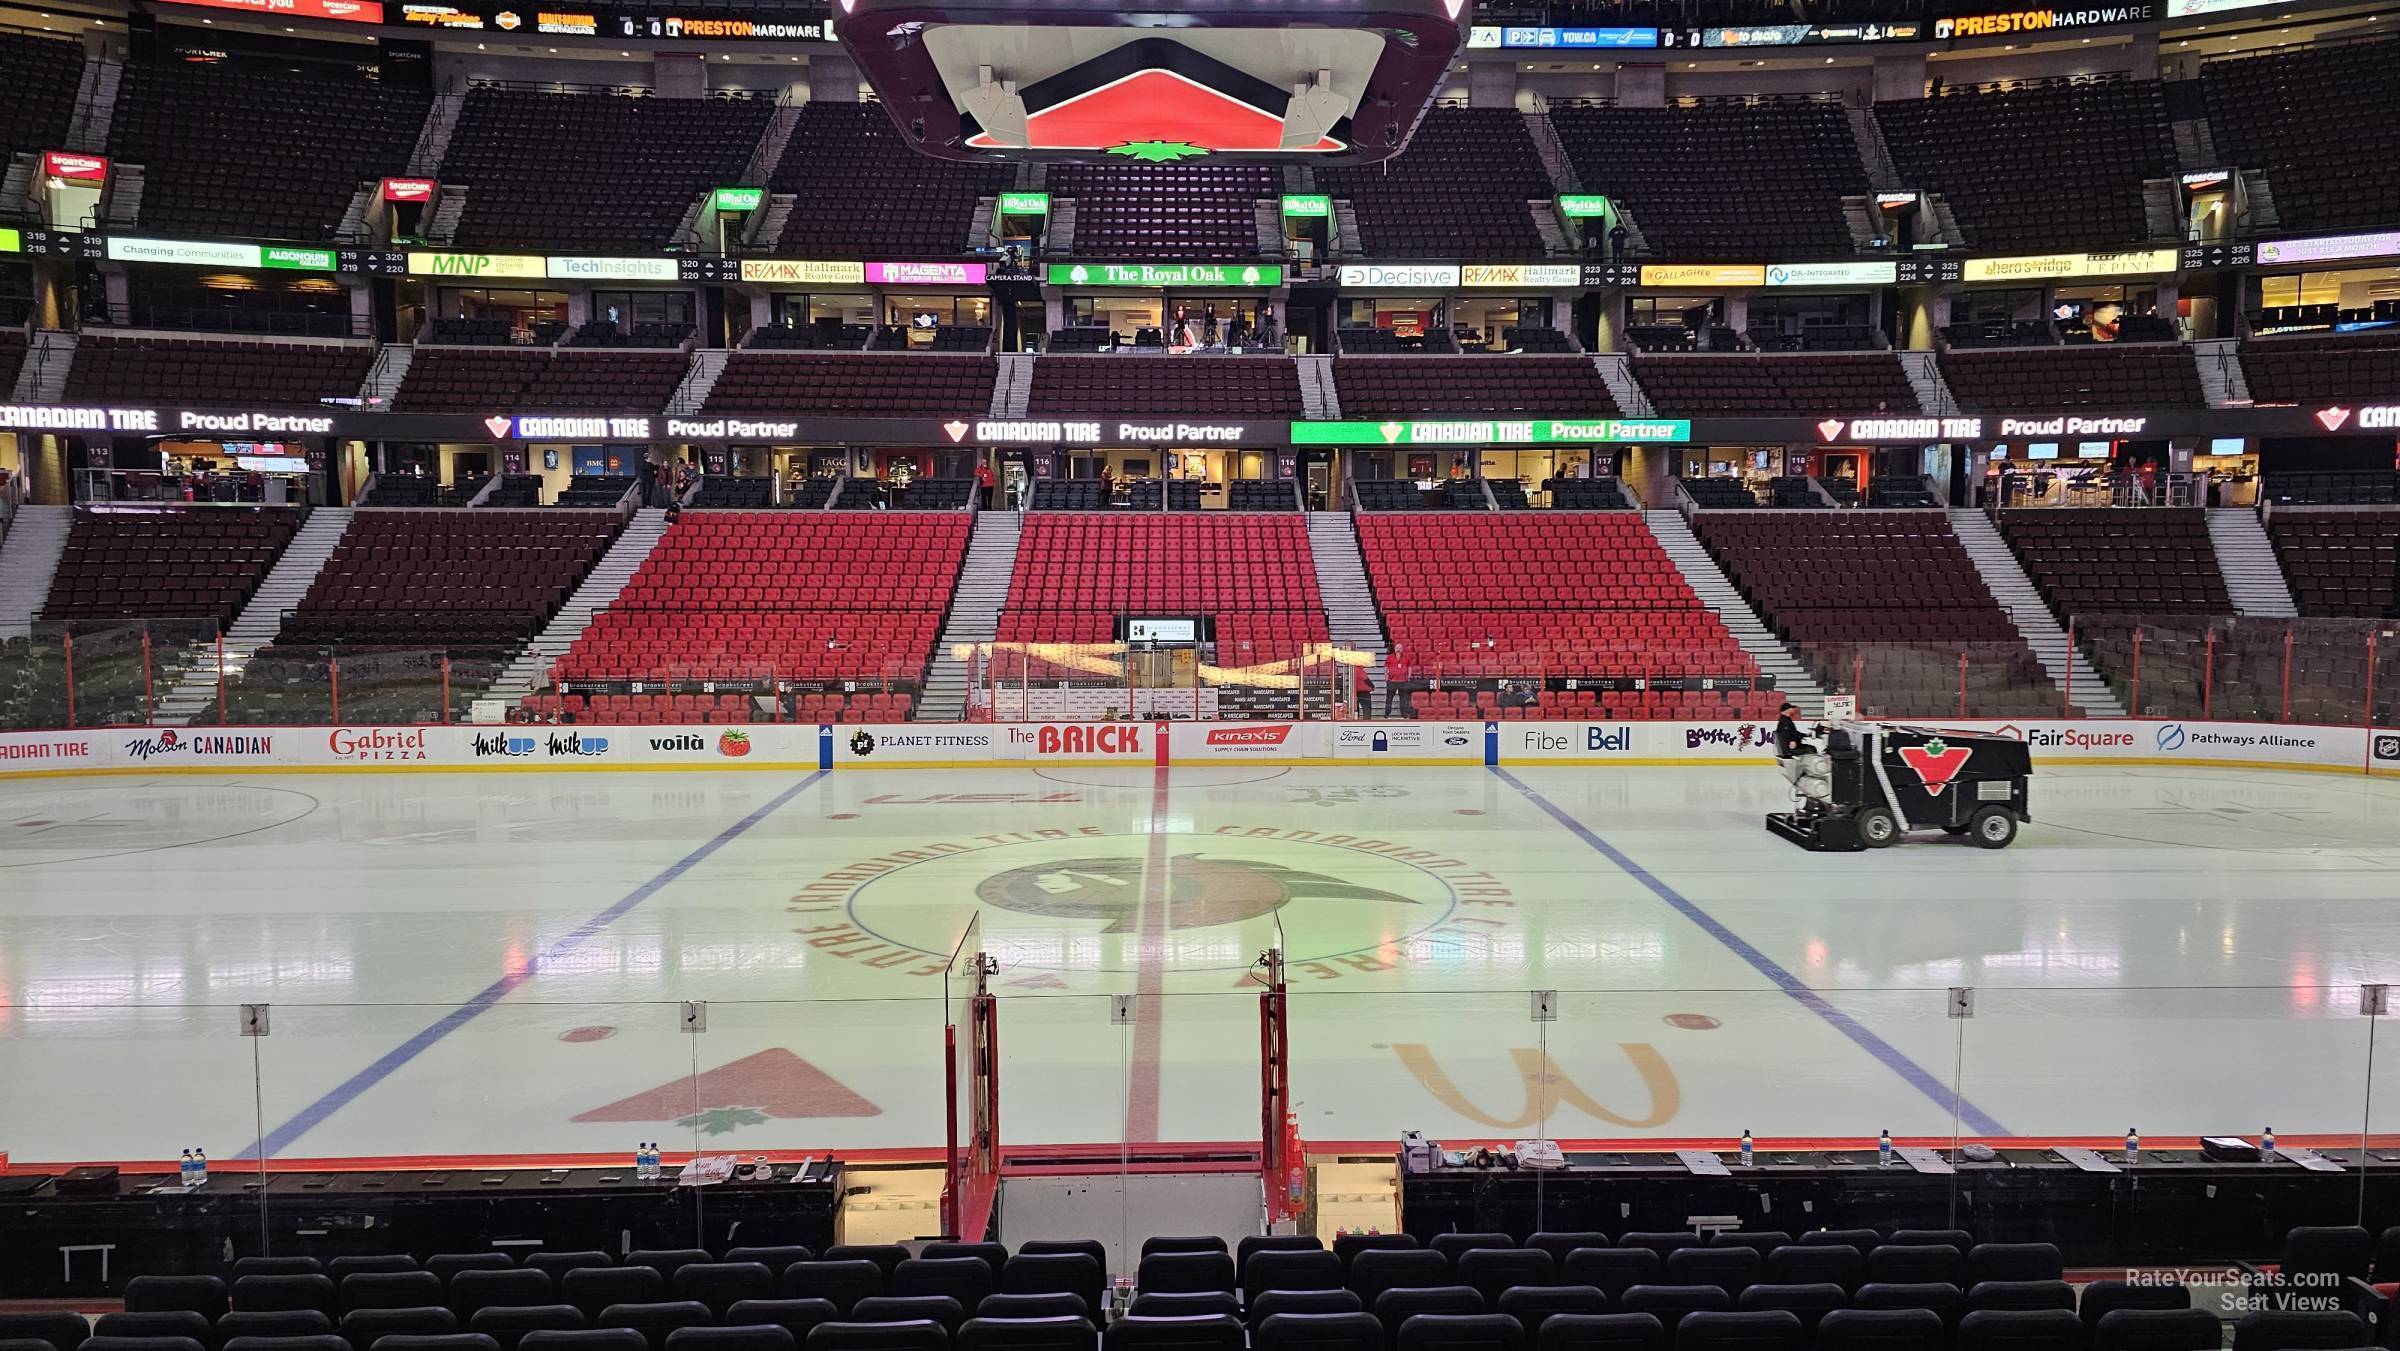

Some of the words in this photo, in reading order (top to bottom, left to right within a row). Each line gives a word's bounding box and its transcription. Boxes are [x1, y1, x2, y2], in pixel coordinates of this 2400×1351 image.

[51, 155, 102, 168] SPORTCHEK
[389, 182, 431, 193] SPORTCHEK
[27, 232, 47, 241] 318
[83, 236, 103, 245] 319
[27, 244, 47, 254] 218
[83, 249, 102, 258] 219
[122, 245, 174, 257] Changing
[176, 248, 244, 260] Communities
[2185, 249, 2203, 258] 325
[2231, 246, 2250, 254] 326
[341, 252, 357, 260] 319
[385, 253, 403, 261] 320
[2231, 256, 2250, 264] 226
[342, 264, 358, 272] 219
[386, 265, 404, 273] 220
[431, 256, 490, 275] MNP
[562, 259, 662, 277] TechInsights
[681, 260, 699, 268] 320
[722, 260, 737, 268] 321
[1900, 263, 1917, 271] 324
[1942, 262, 1958, 270] 325
[2185, 260, 2202, 268] 225
[744, 263, 800, 279] RE/MAX
[805, 263, 860, 272] Hallmark
[901, 265, 967, 275] MAGENTA
[1105, 266, 1140, 282] The
[1142, 266, 1188, 285] Royal
[1191, 266, 1226, 281] Oak
[1464, 268, 1519, 283] RE/MAX
[1523, 267, 1577, 275] Hallmark
[1585, 266, 1601, 274] 323
[1621, 266, 1637, 274] 324
[682, 272, 699, 280] 220
[722, 272, 737, 280] 221
[1369, 268, 1451, 284] Decisive
[1584, 277, 1600, 285] 223
[1621, 277, 1637, 285] 224
[1900, 273, 1917, 281] 224
[1942, 272, 1958, 280] 225
[109, 410, 158, 434] TIRE
[180, 411, 250, 434] Proud
[253, 414, 333, 436] Partner
[2001, 417, 2064, 436] Proud
[2067, 416, 2146, 436] Partner
[519, 418, 609, 439] CANADIAN
[609, 418, 650, 439] TIRE
[668, 420, 725, 437] Proud
[727, 420, 798, 437] Partner
[976, 421, 1061, 442] CANADIAN
[1063, 422, 1101, 441] TIRE
[1119, 423, 1174, 441] Proud
[1177, 424, 1244, 441] Partner
[1411, 422, 1493, 442] CANADIAN
[1496, 422, 1533, 442] TIRE
[1551, 422, 1605, 440] Proud
[1609, 421, 1676, 439] Partner
[1850, 418, 1939, 439] CANADIAN
[1941, 417, 1982, 438] TIRE
[90, 448, 108, 456] 113
[821, 458, 847, 466] TAGG
[329, 728, 427, 755] Gabriel
[881, 736, 933, 747] PLANET
[935, 736, 989, 746] FITNESS
[1007, 727, 1035, 744] The
[1038, 725, 1140, 754] BRICK
[1340, 730, 1366, 742] Ford
[1525, 730, 1568, 751] Fibe
[1587, 726, 1631, 751] Bell
[1685, 727, 1738, 749] Booster
[2028, 729, 2134, 751] FairSquare
[2191, 733, 2256, 747] Pathways
[2259, 735, 2316, 748] Alliance
[0, 743, 49, 760] ADIAN
[53, 742, 89, 758] TIRE
[125, 739, 188, 760] Molson
[194, 735, 271, 755] CANADIAN
[360, 751, 426, 760] PIZZA
